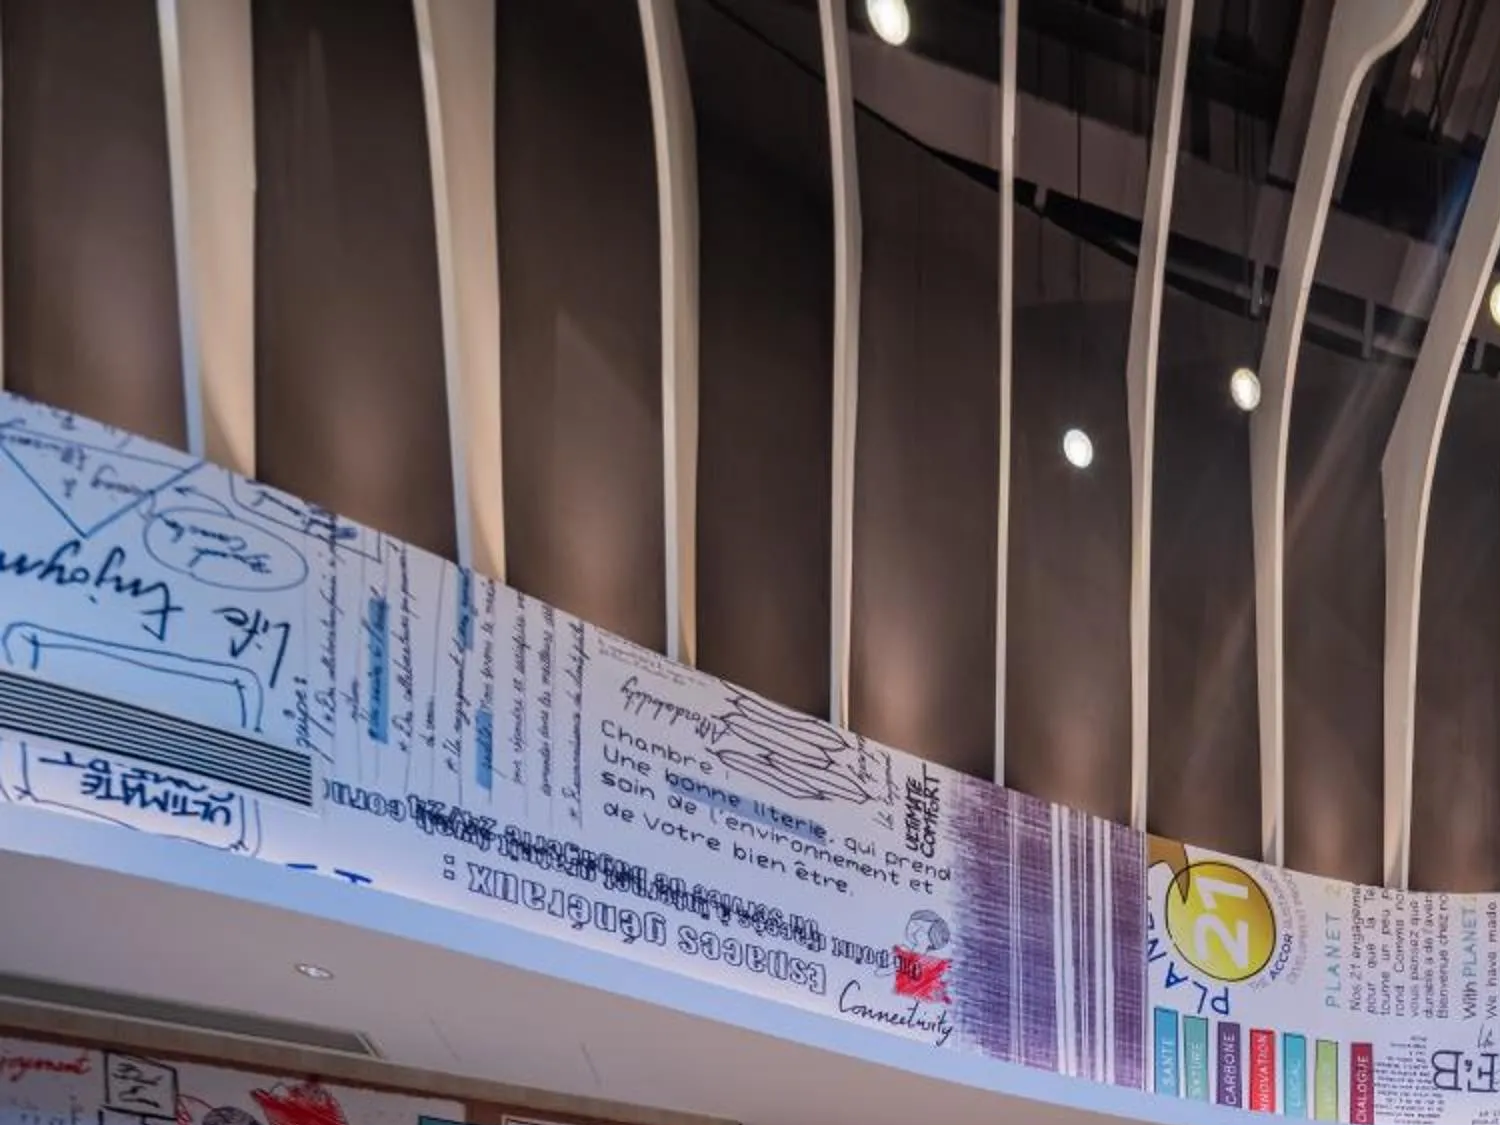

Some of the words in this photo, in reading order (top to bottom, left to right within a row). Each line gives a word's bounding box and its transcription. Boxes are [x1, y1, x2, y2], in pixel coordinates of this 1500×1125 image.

[213, 605, 291, 688] Life
[619, 673, 731, 744] Affordability
[600, 718, 714, 778] Chambre
[600, 770, 655, 801] soin
[668, 791, 697, 816] de
[709, 807, 901, 888] l'environnement
[909, 875, 935, 896] et
[602, 745, 652, 778] Une
[665, 771, 741, 806] bonne
[844, 832, 880, 859] qui
[884, 848, 952, 884] prend
[602, 803, 635, 827] de
[732, 839, 785, 874] bien
[465, 859, 666, 942] généraux
[1193, 876, 1249, 968] 21
[1364, 917, 1375, 929] la
[1381, 909, 1392, 935] peu
[1408, 900, 1421, 925] que
[1486, 902, 1497, 942] made
[1381, 943, 1391, 961] un
[1394, 919, 1405, 973] Comme
[1423, 937, 1433, 953] de
[1436, 914, 1449, 946] chez
[1463, 906, 1477, 976] PLANET
[677, 922, 827, 996] Espaces
[1268, 932, 1292, 981] ACCOR
[1324, 911, 1342, 1009] PLANET
[1350, 963, 1362, 981] 21
[1366, 943, 1377, 968] que
[1409, 930, 1421, 981] pensez
[1486, 952, 1497, 987] have
[1350, 984, 1362, 1011] Nos
[1365, 983, 1377, 1015] pour
[1409, 984, 1419, 1017] vous
[1422, 969, 1434, 1018] durable
[1436, 950, 1449, 1019] Bienvenue
[1461, 981, 1477, 1019] With
[1486, 996, 1497, 1018] We
[838, 980, 954, 1047] Connectivity
[1223, 1033, 1237, 1105] CARBONE
[1355, 1055, 1368, 1123] DIALOGUE
